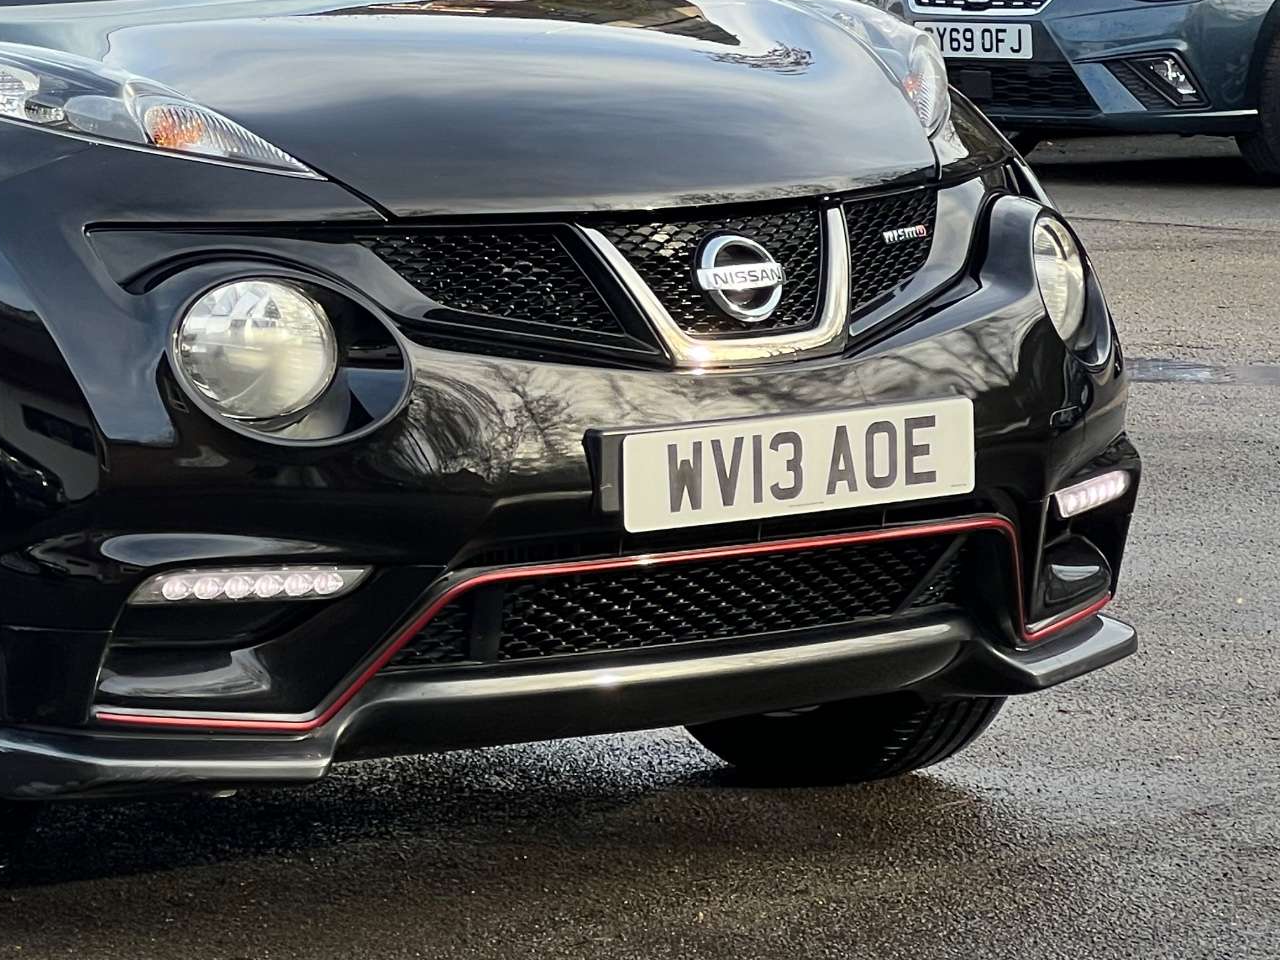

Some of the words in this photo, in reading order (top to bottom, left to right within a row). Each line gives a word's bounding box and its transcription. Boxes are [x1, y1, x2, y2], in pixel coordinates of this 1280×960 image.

[981, 28, 1022, 53] OFJ
[713, 267, 781, 285] NISSAN
[667, 432, 803, 513] WV13
[826, 415, 936, 495] AOE
